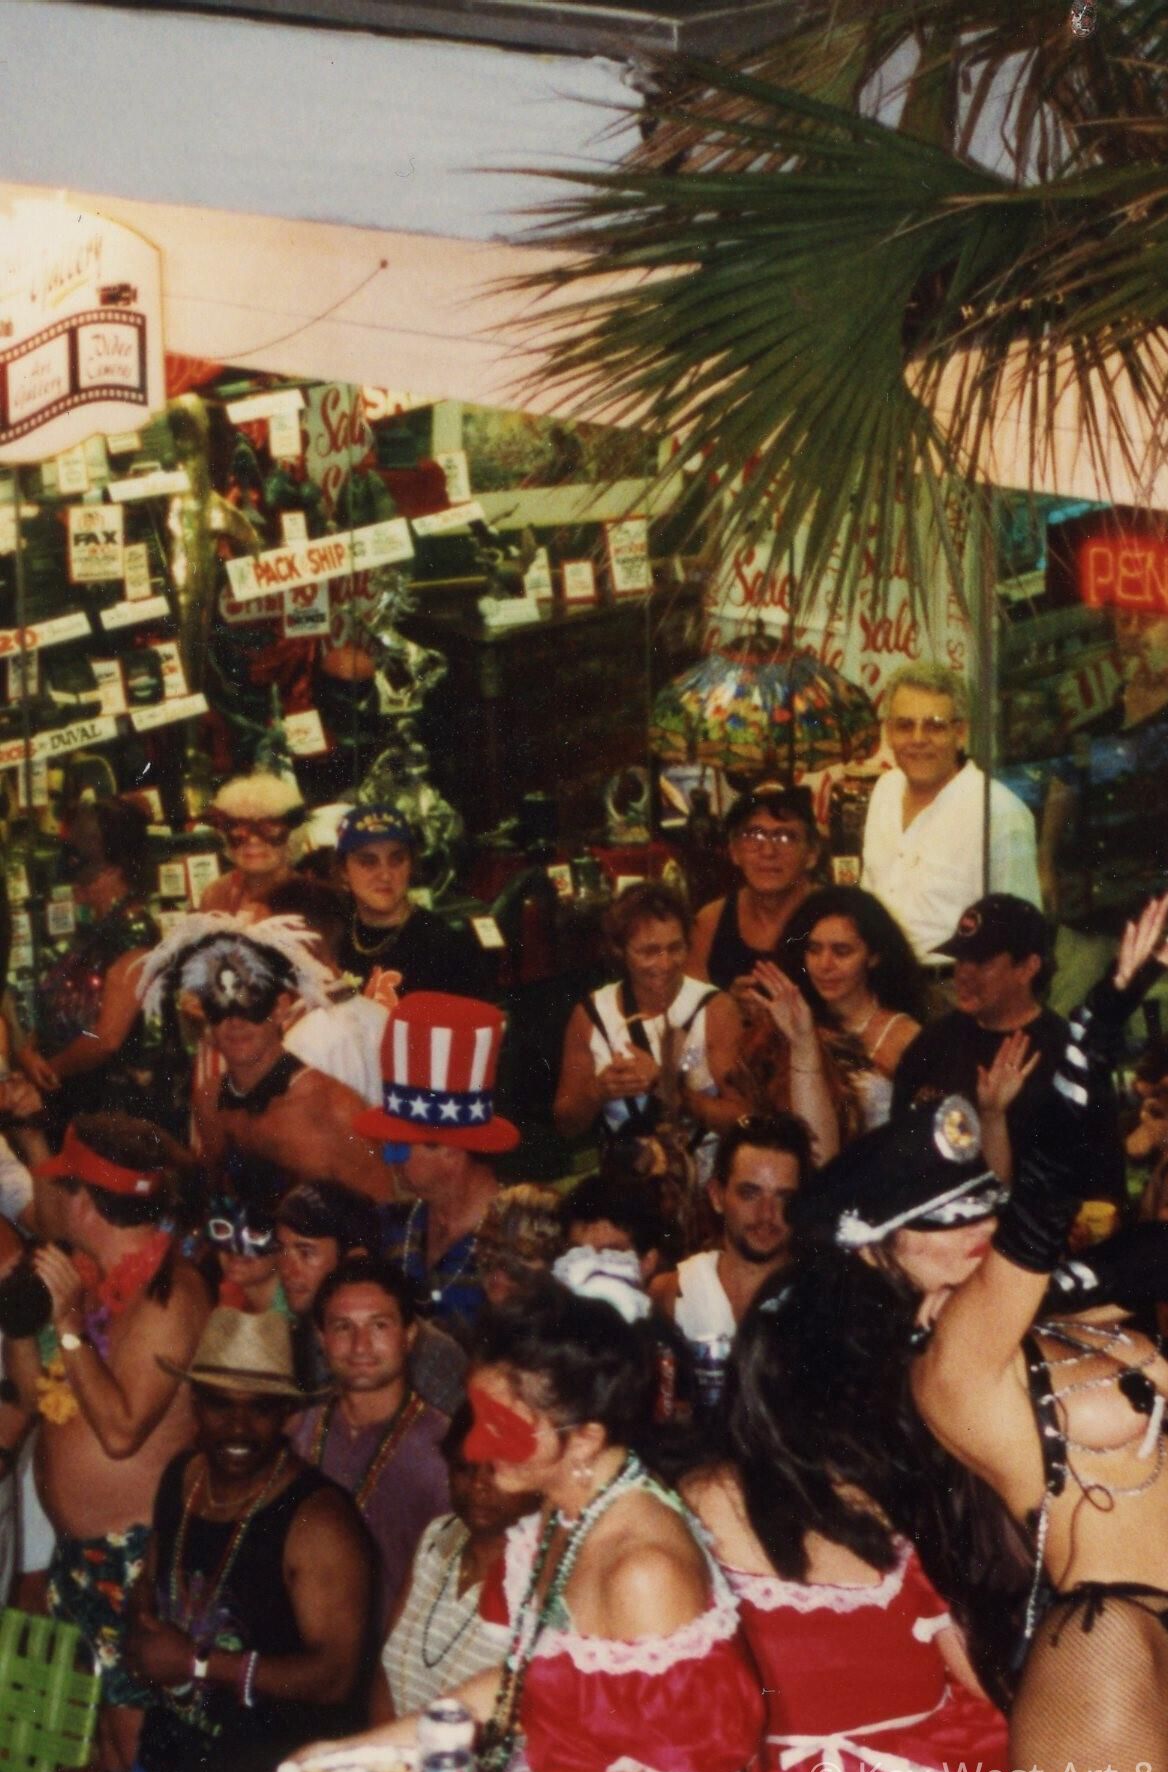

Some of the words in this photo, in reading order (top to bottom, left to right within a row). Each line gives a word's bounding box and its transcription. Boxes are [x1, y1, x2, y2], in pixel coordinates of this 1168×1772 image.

[74, 531, 117, 546] FAX
[252, 554, 302, 586] PACK
[307, 543, 346, 575] SHIP
[50, 724, 102, 749] DUVAL
